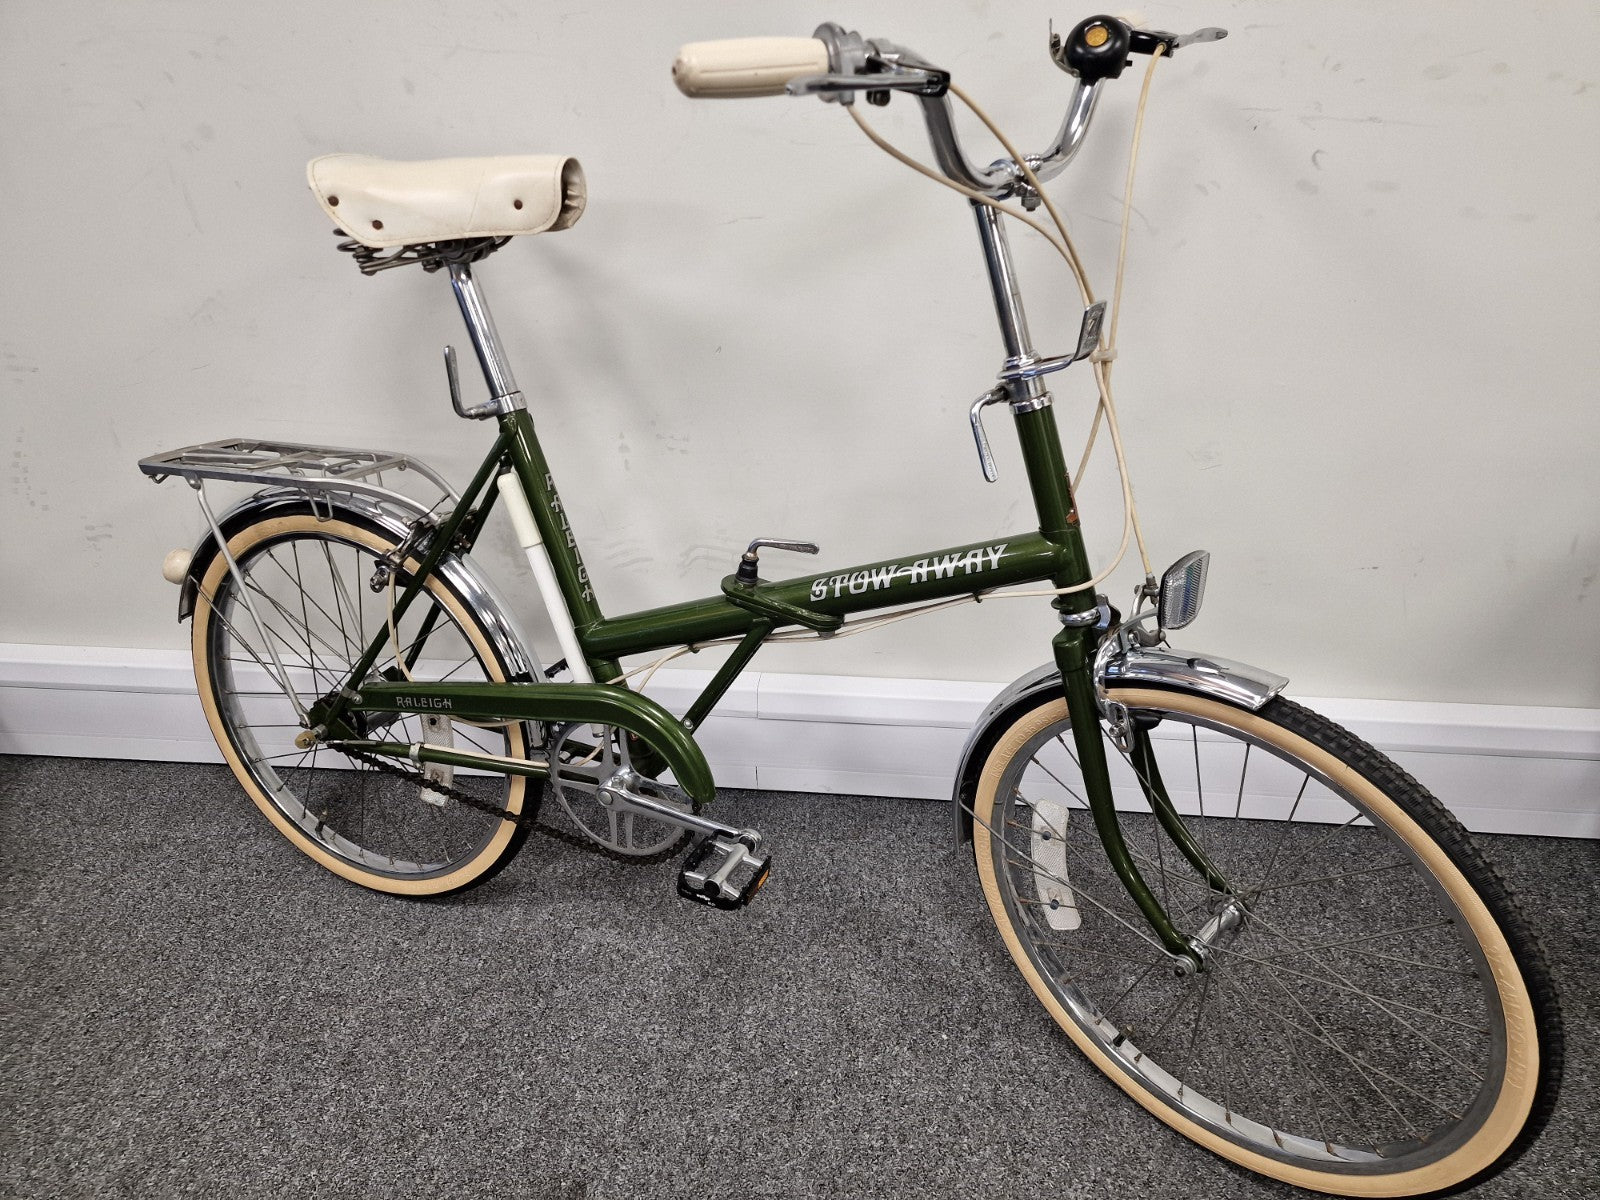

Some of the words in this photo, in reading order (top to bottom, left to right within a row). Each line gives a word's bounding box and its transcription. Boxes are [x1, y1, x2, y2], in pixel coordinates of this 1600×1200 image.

[810, 564, 900, 602] STOW
[899, 543, 1009, 584] AWAY
[396, 696, 452, 709] RALEIGH
